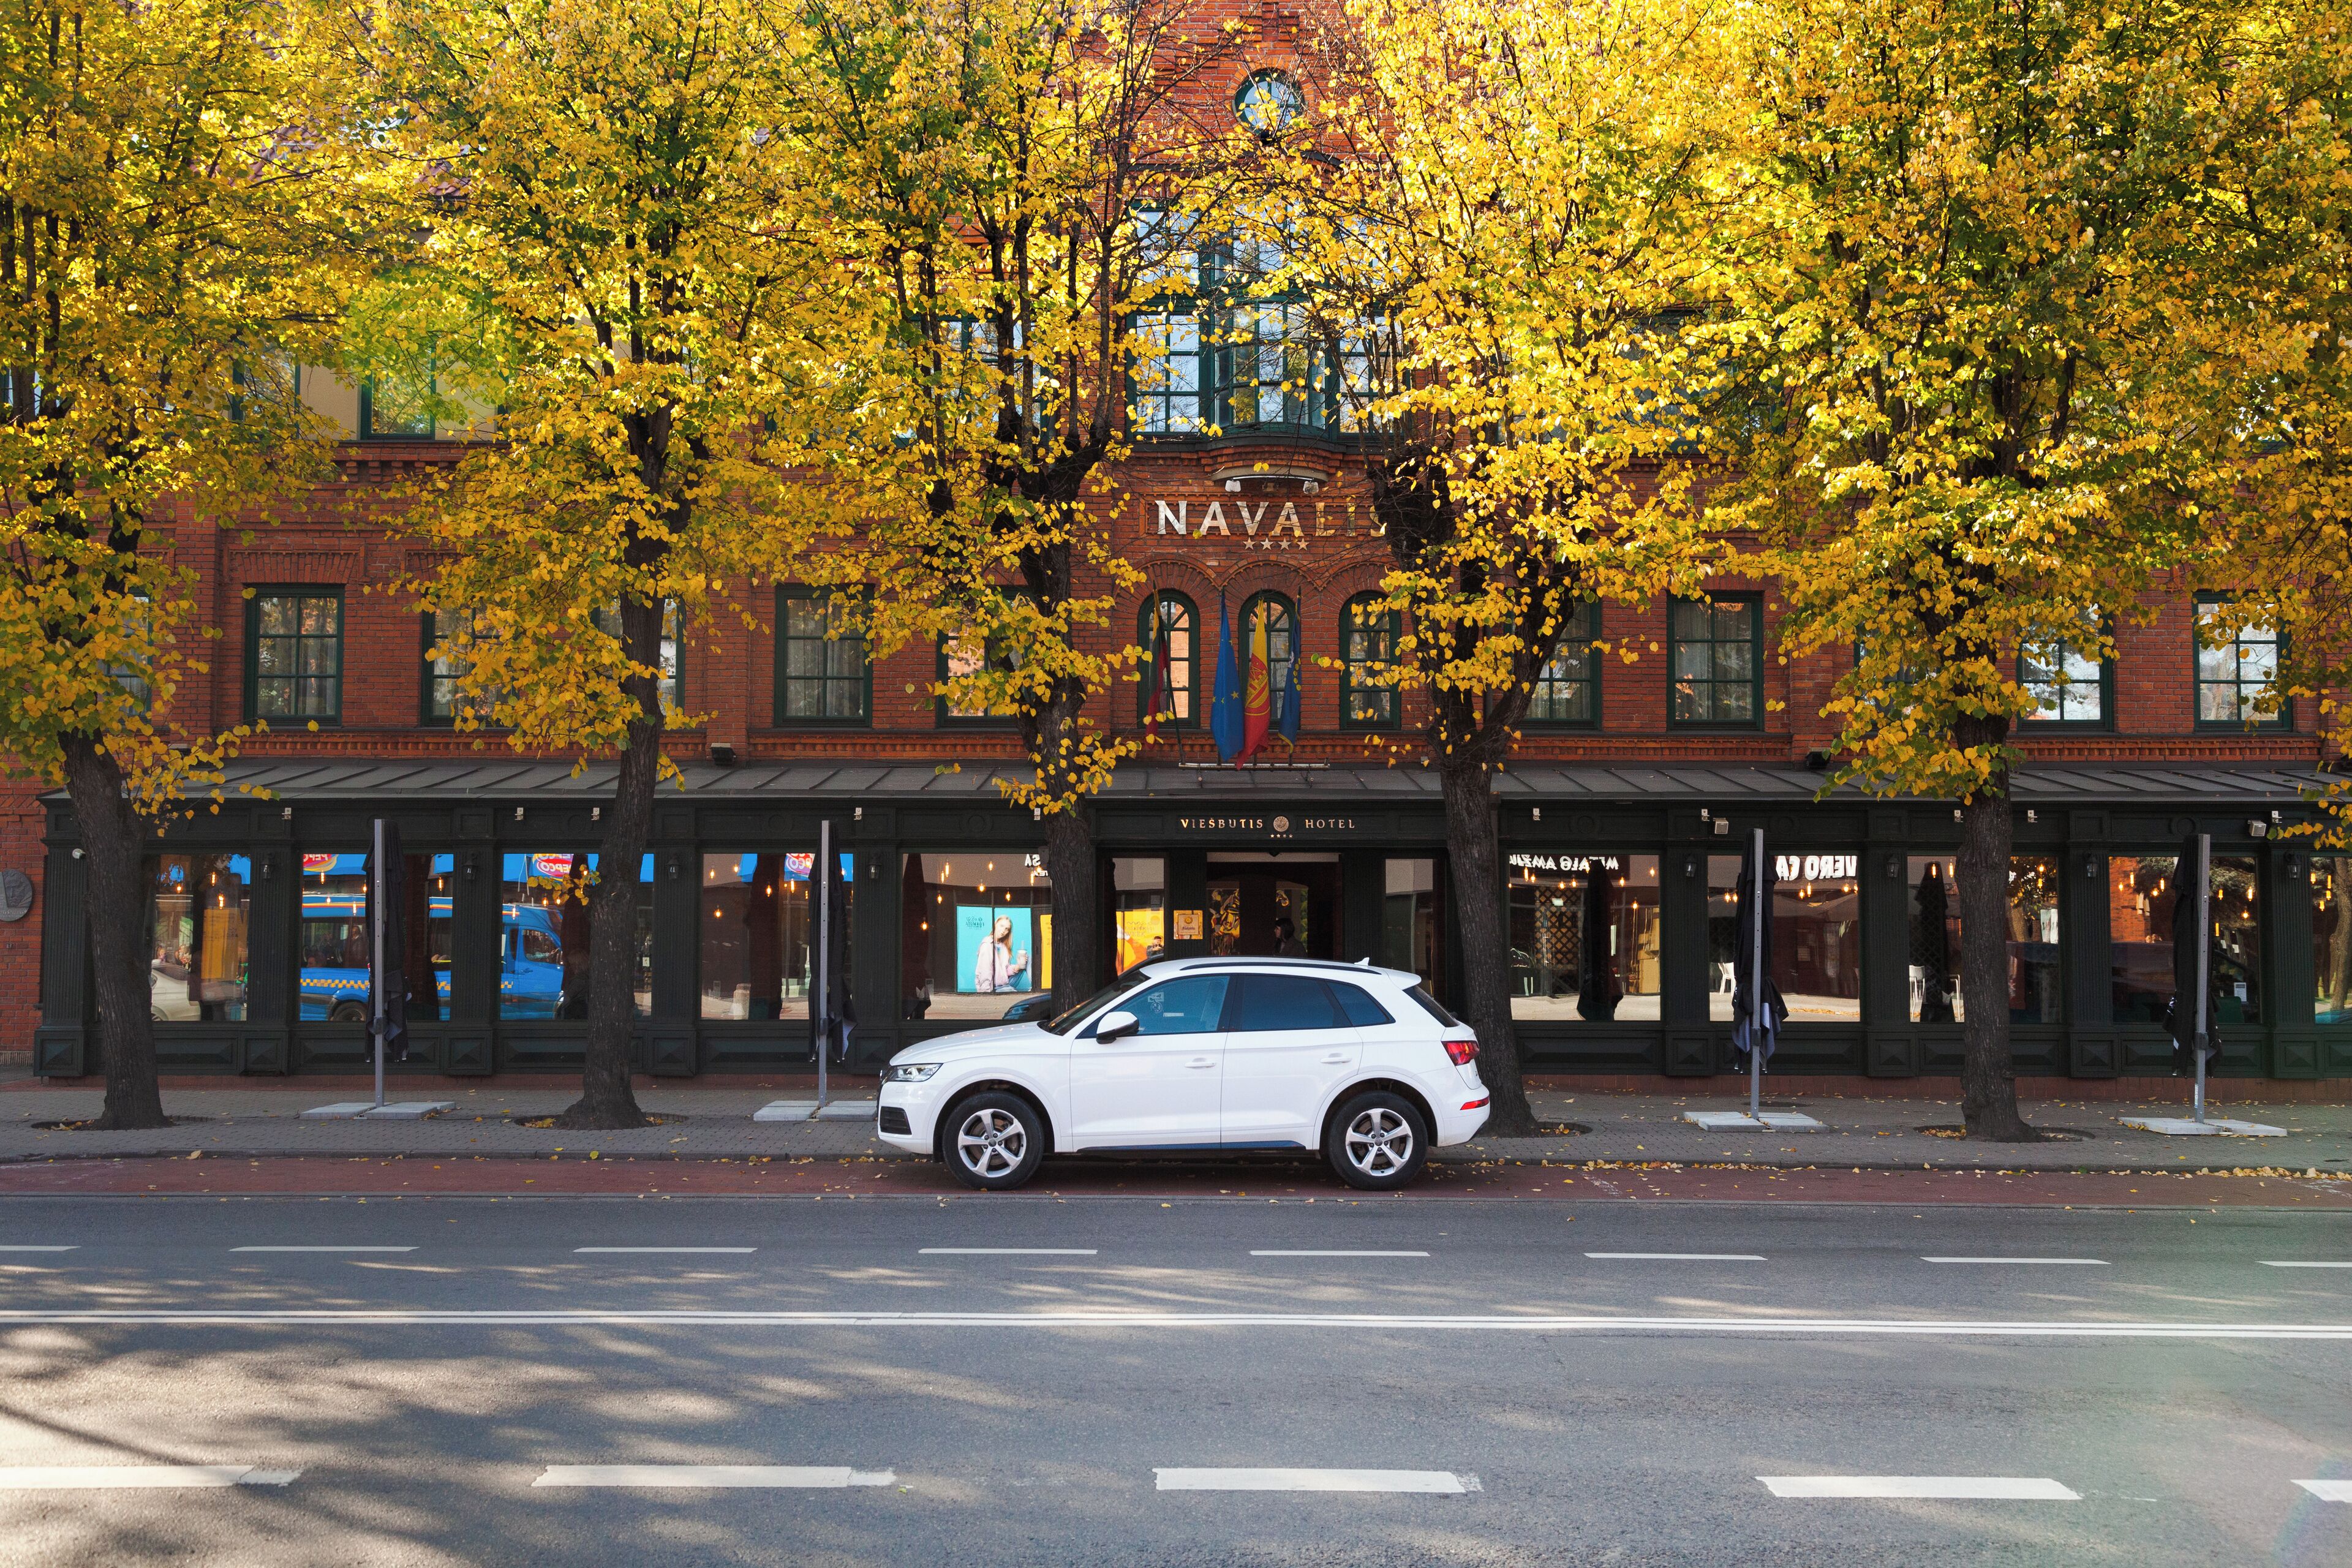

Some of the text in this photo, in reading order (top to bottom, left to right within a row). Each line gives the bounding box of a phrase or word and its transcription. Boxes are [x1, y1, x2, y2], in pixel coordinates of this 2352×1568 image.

[1155, 500, 1386, 537] NAVALIS
[1180, 817, 1263, 829] VIEŠBUTIS
[1305, 819, 1355, 828] HOTEL
